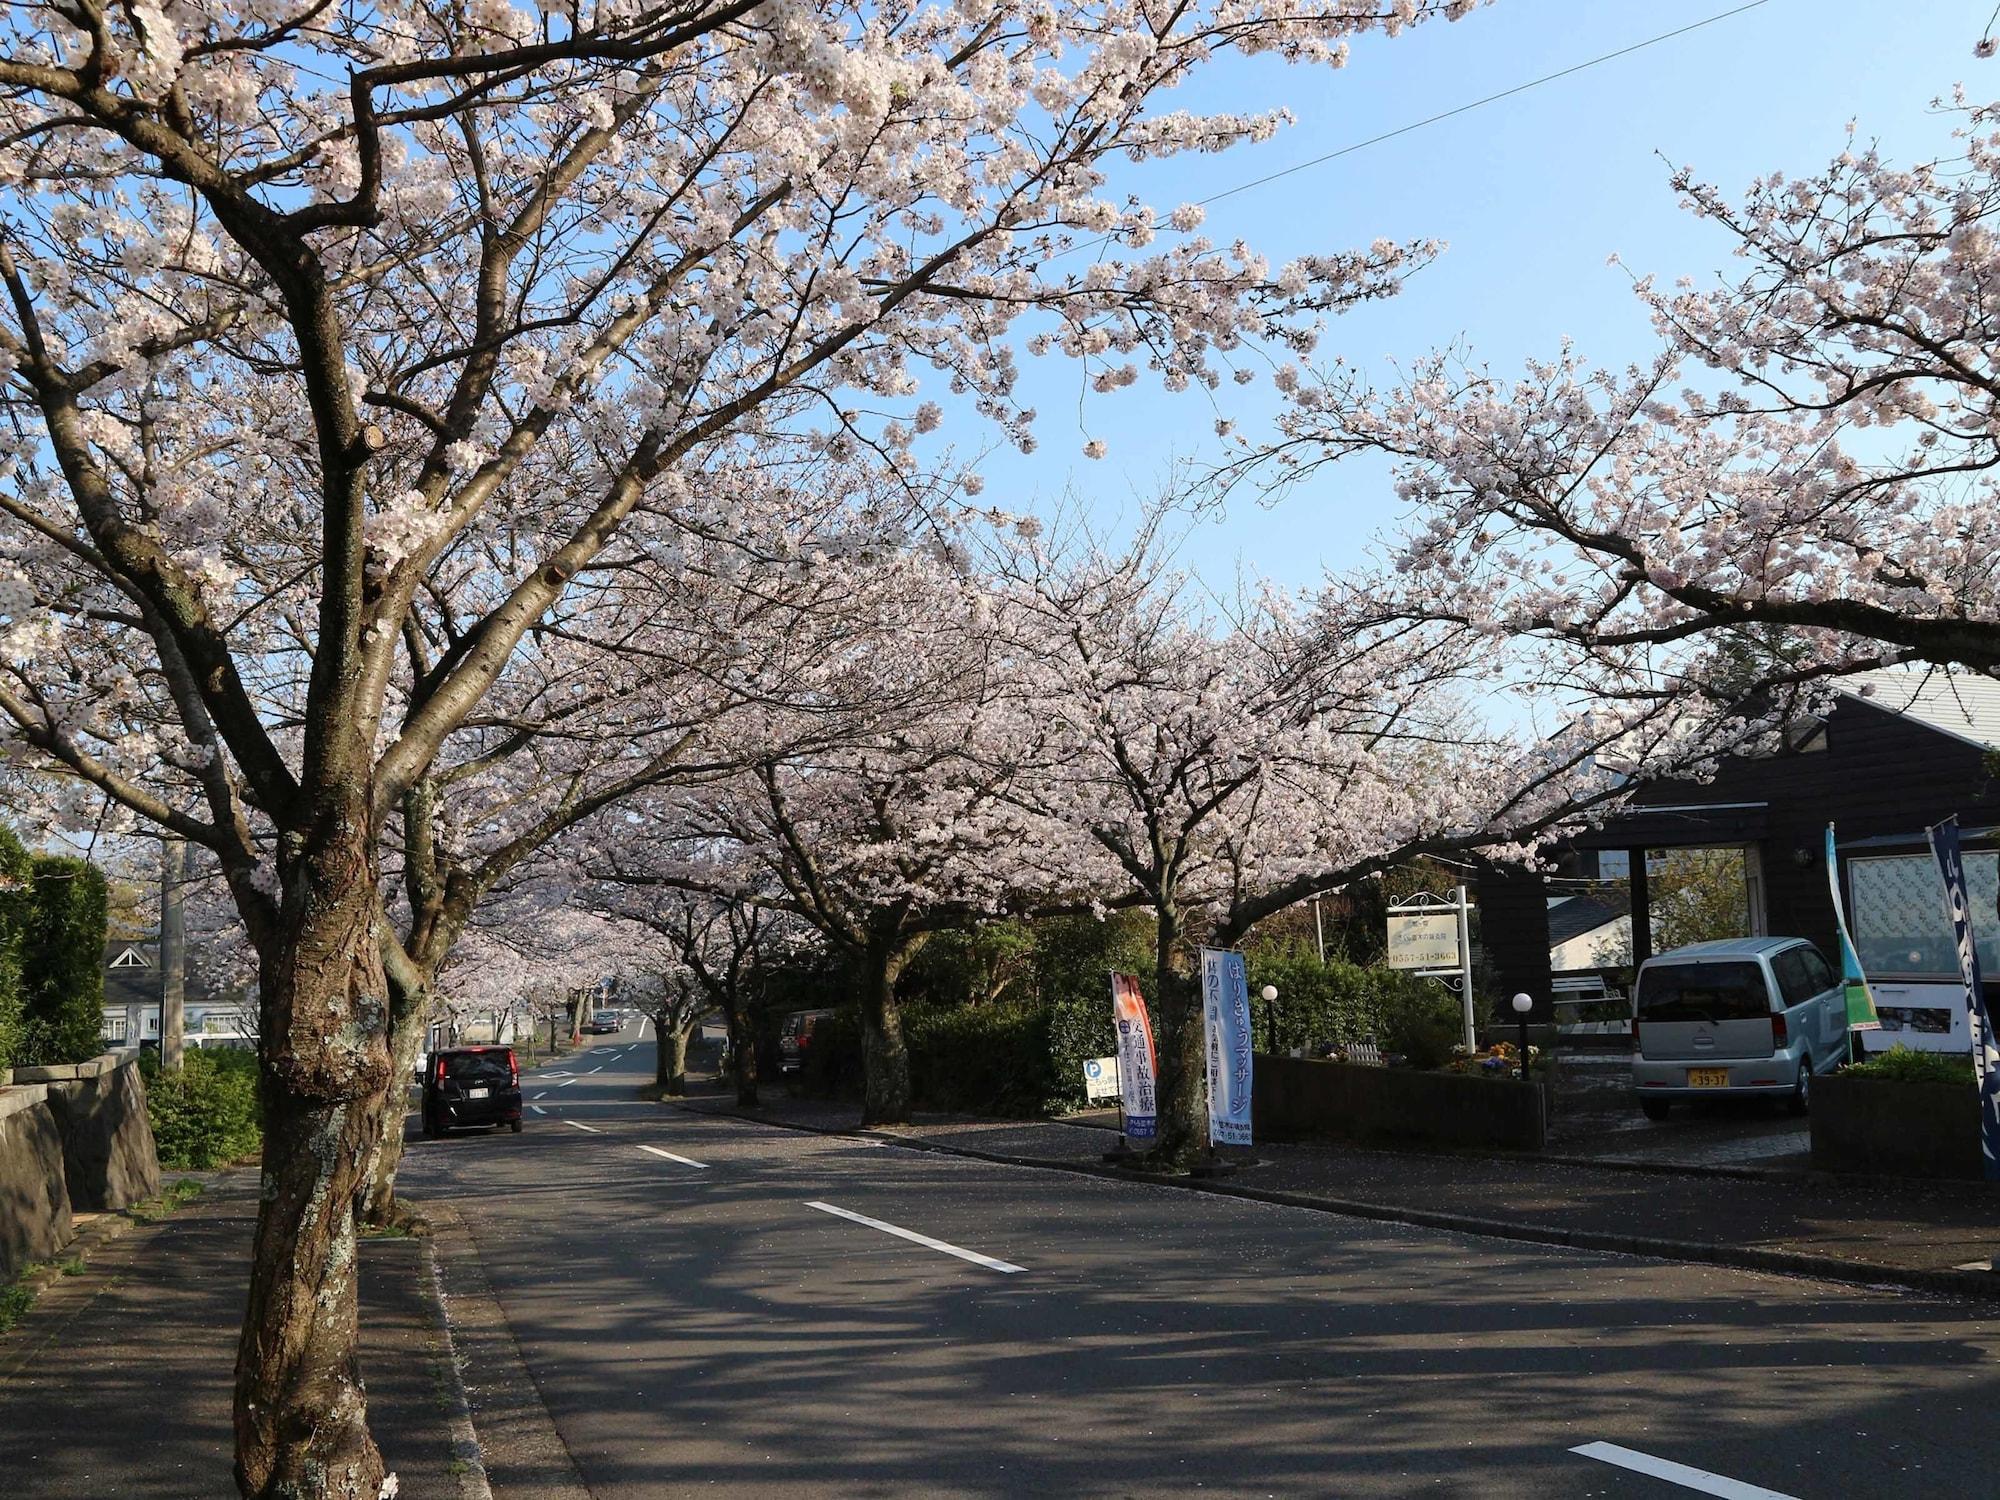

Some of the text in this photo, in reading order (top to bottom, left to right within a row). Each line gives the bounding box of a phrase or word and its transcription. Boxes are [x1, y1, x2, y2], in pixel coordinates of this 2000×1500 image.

[1131, 1018, 1155, 1112] 交通事故治療
[1698, 1075, 1725, 1086] 39-37
